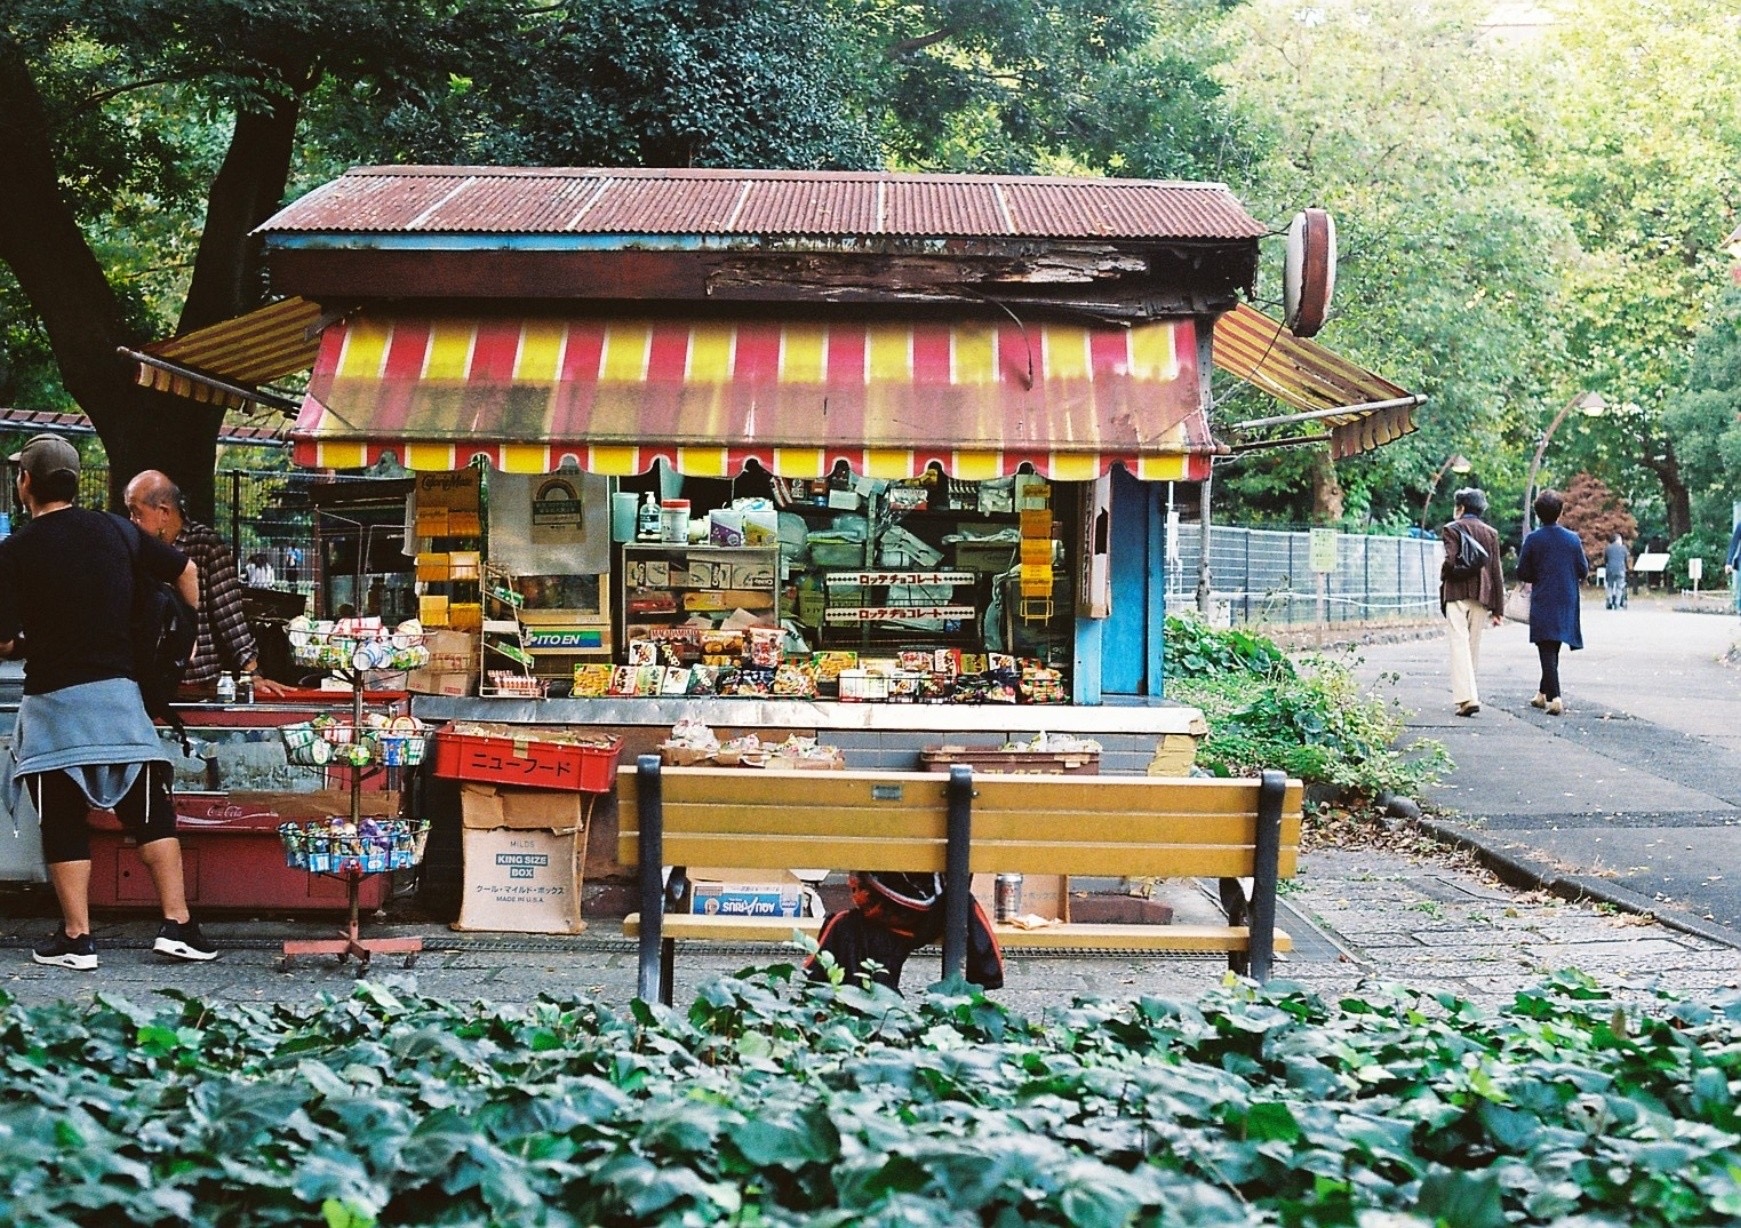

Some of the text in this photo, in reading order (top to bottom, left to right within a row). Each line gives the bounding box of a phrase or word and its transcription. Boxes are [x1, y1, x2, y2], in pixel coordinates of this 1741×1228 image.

[859, 574, 942, 585] ロッテチョコレート
[537, 634, 581, 645] ITO EN
[472, 753, 570, 777] ニューフード
[497, 855, 547, 865] KING SIZE
[511, 867, 533, 877] BOX
[722, 896, 775, 917] AQUARIUS
